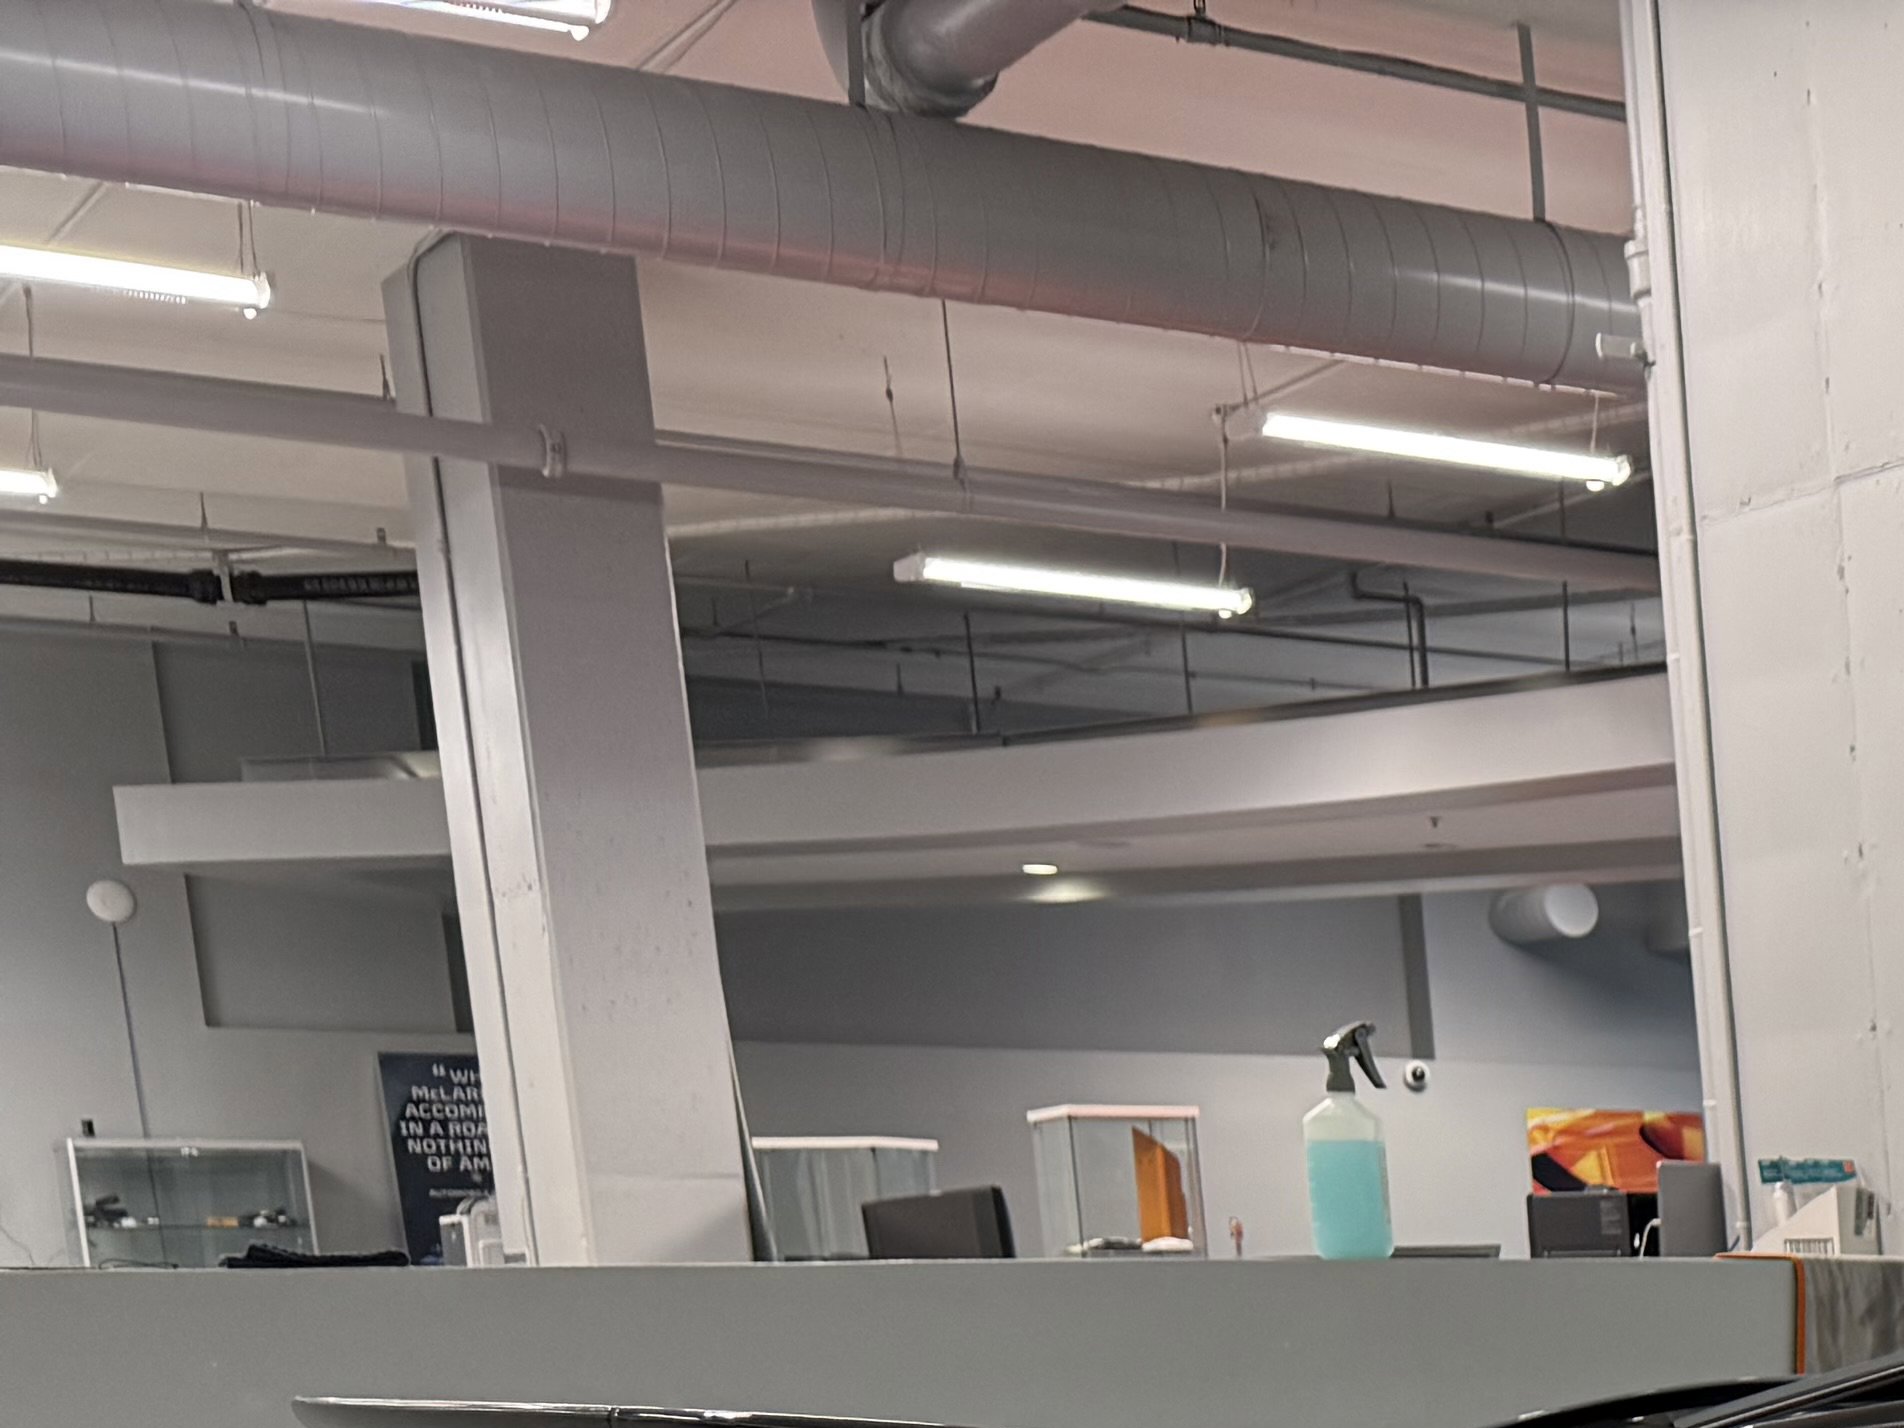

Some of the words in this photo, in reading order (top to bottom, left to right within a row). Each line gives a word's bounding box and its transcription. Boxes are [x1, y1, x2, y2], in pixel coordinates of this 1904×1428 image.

[400, 1119, 424, 1137] IN
[429, 1120, 444, 1137] A
[427, 1155, 453, 1173] OF
